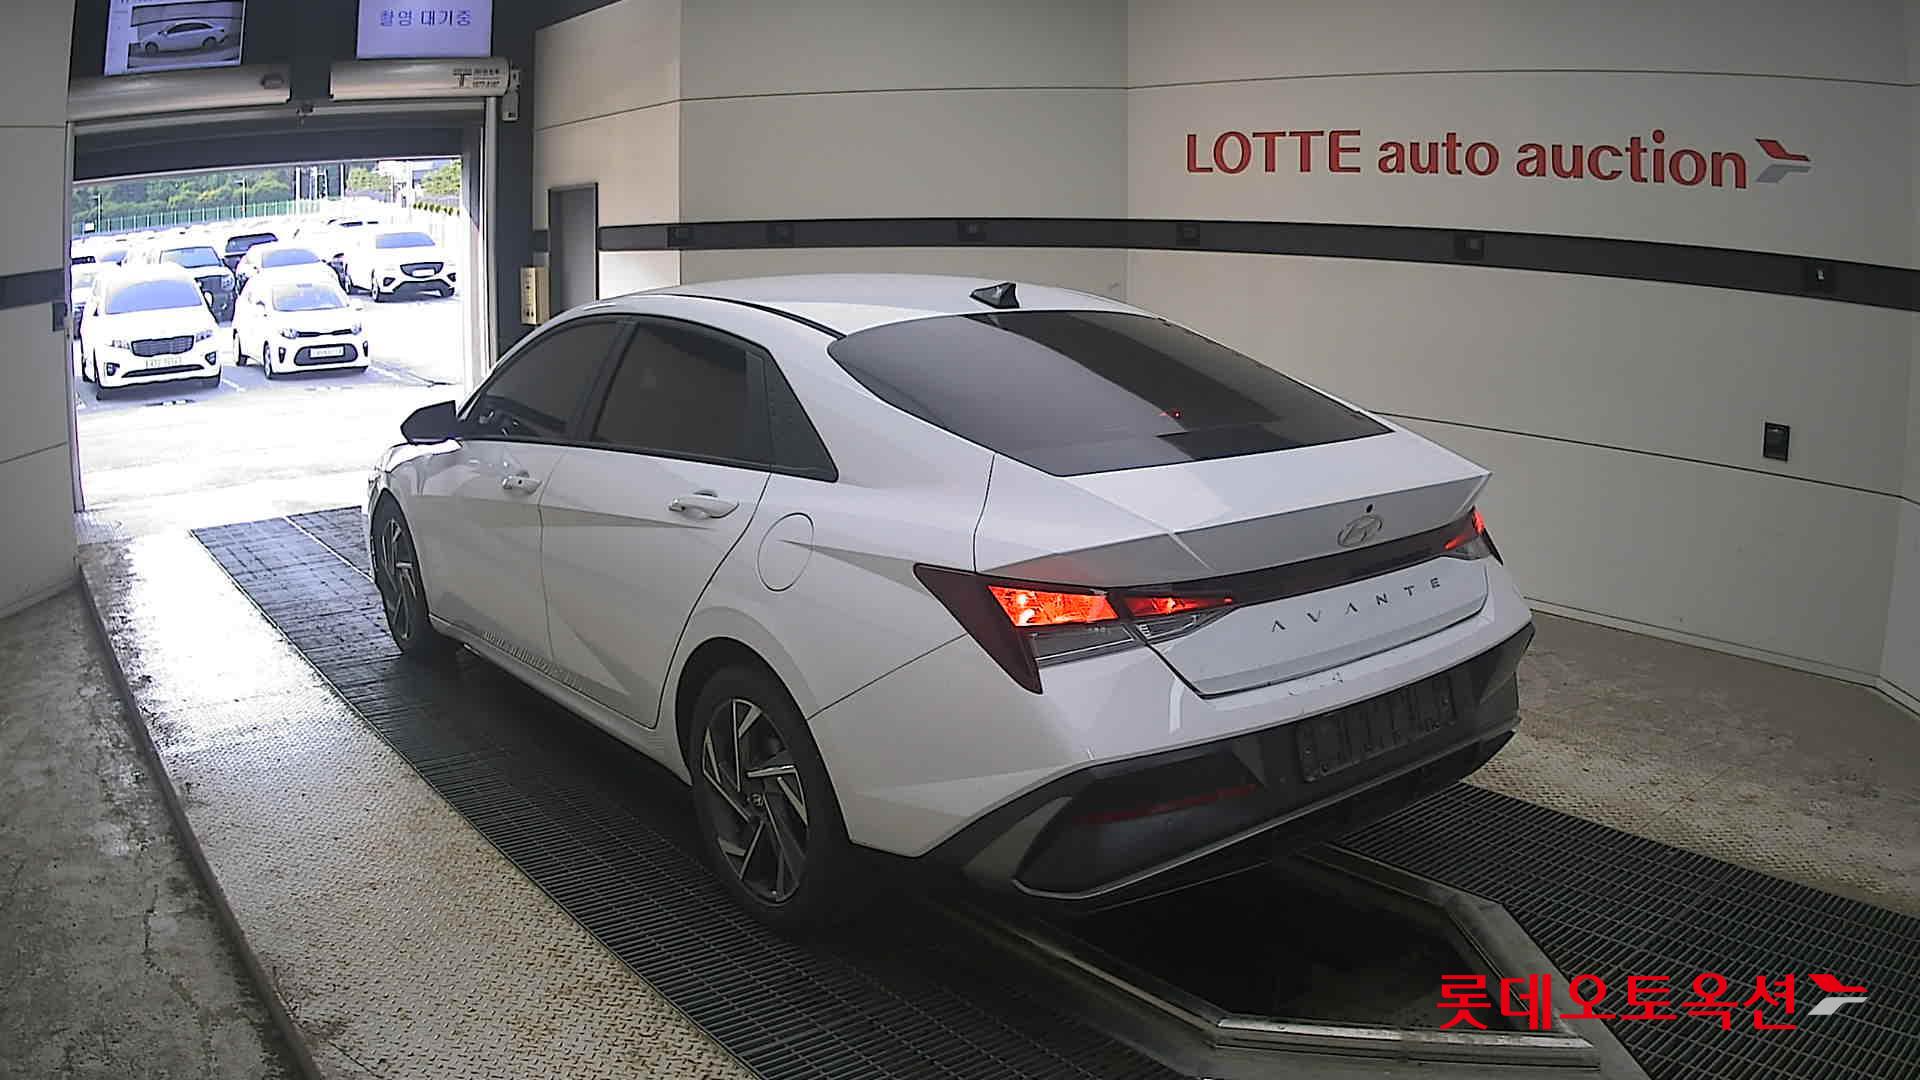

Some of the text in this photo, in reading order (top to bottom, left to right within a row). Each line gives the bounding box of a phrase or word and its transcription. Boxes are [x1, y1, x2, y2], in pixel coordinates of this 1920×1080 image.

[420, 9, 472, 27] 대기중
[1185, 129, 1749, 189] LOTTE auto auction
[1271, 576, 1442, 632] AVANTE
